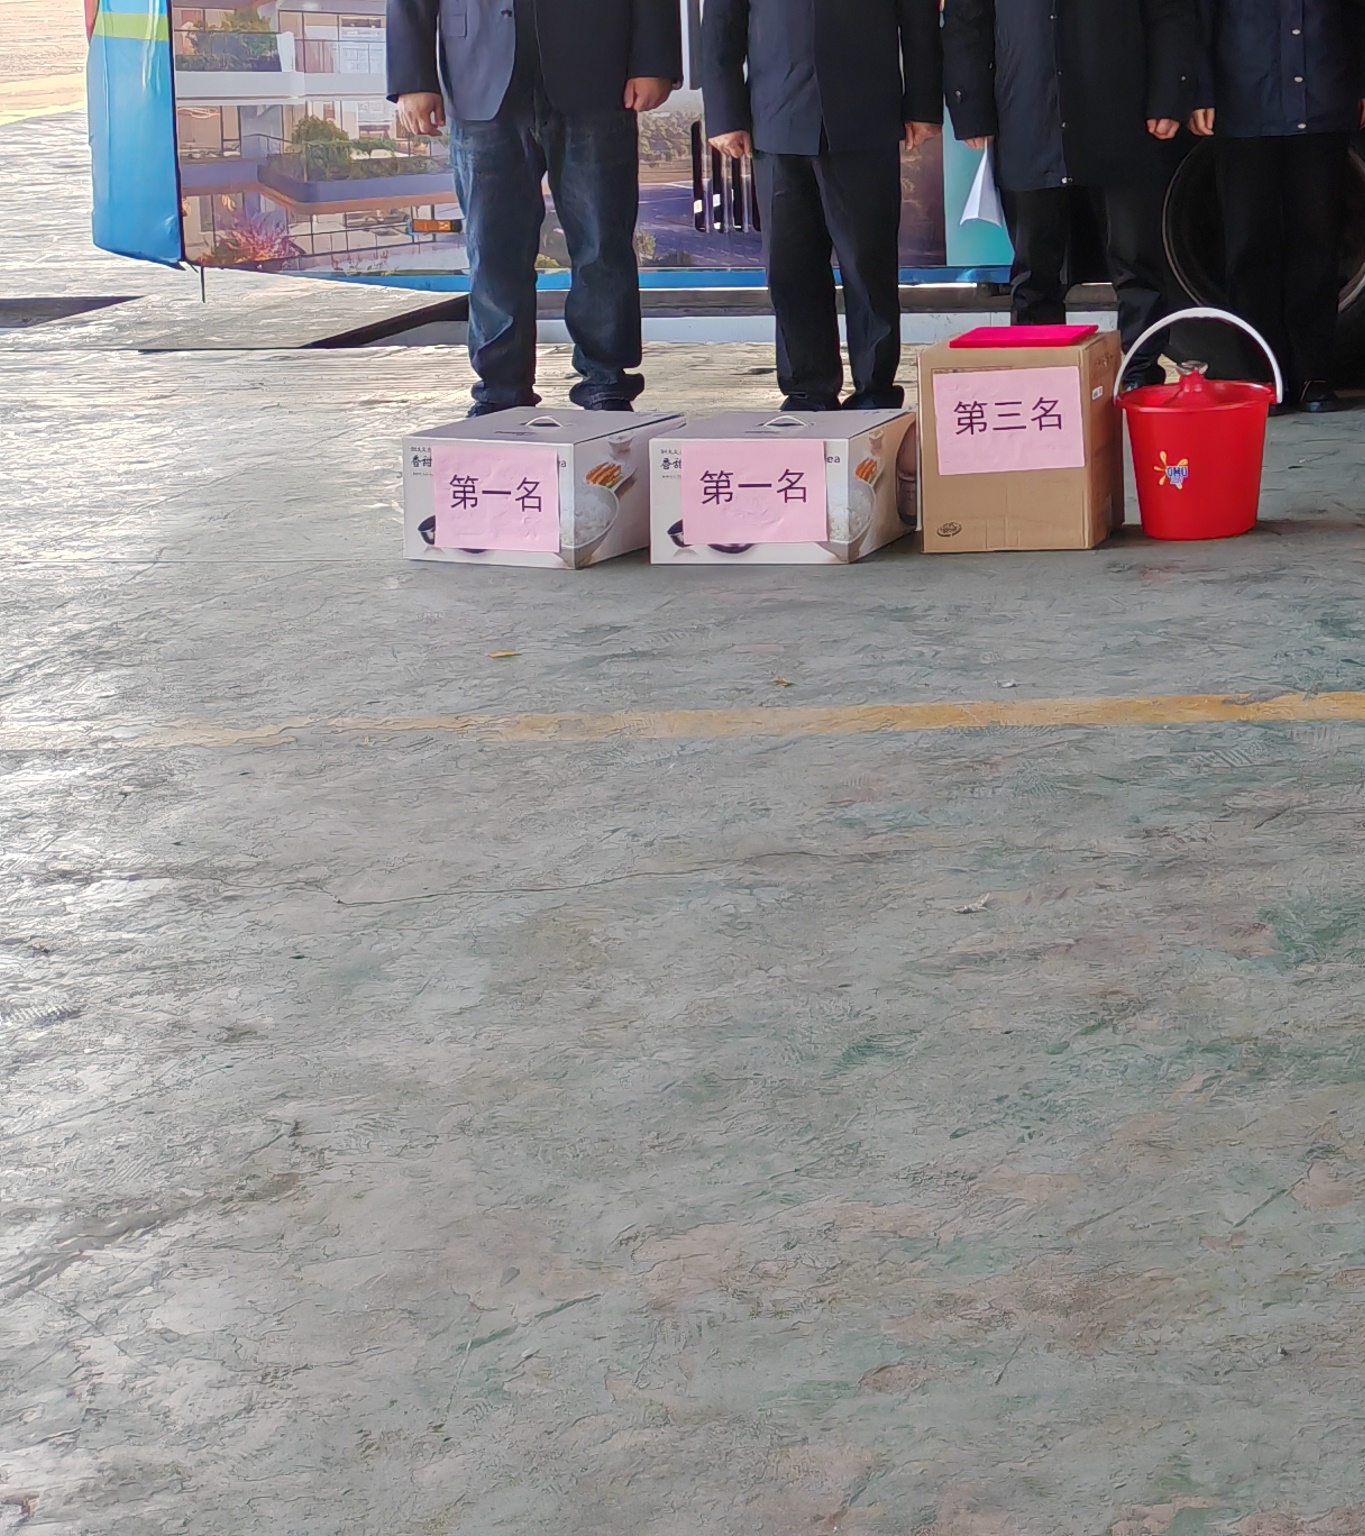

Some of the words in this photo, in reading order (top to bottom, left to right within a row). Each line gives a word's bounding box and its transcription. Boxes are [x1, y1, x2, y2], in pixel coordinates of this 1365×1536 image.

[953, 396, 1063, 436] 第三名
[450, 474, 542, 512] 第一名
[699, 468, 808, 505] 第一名
